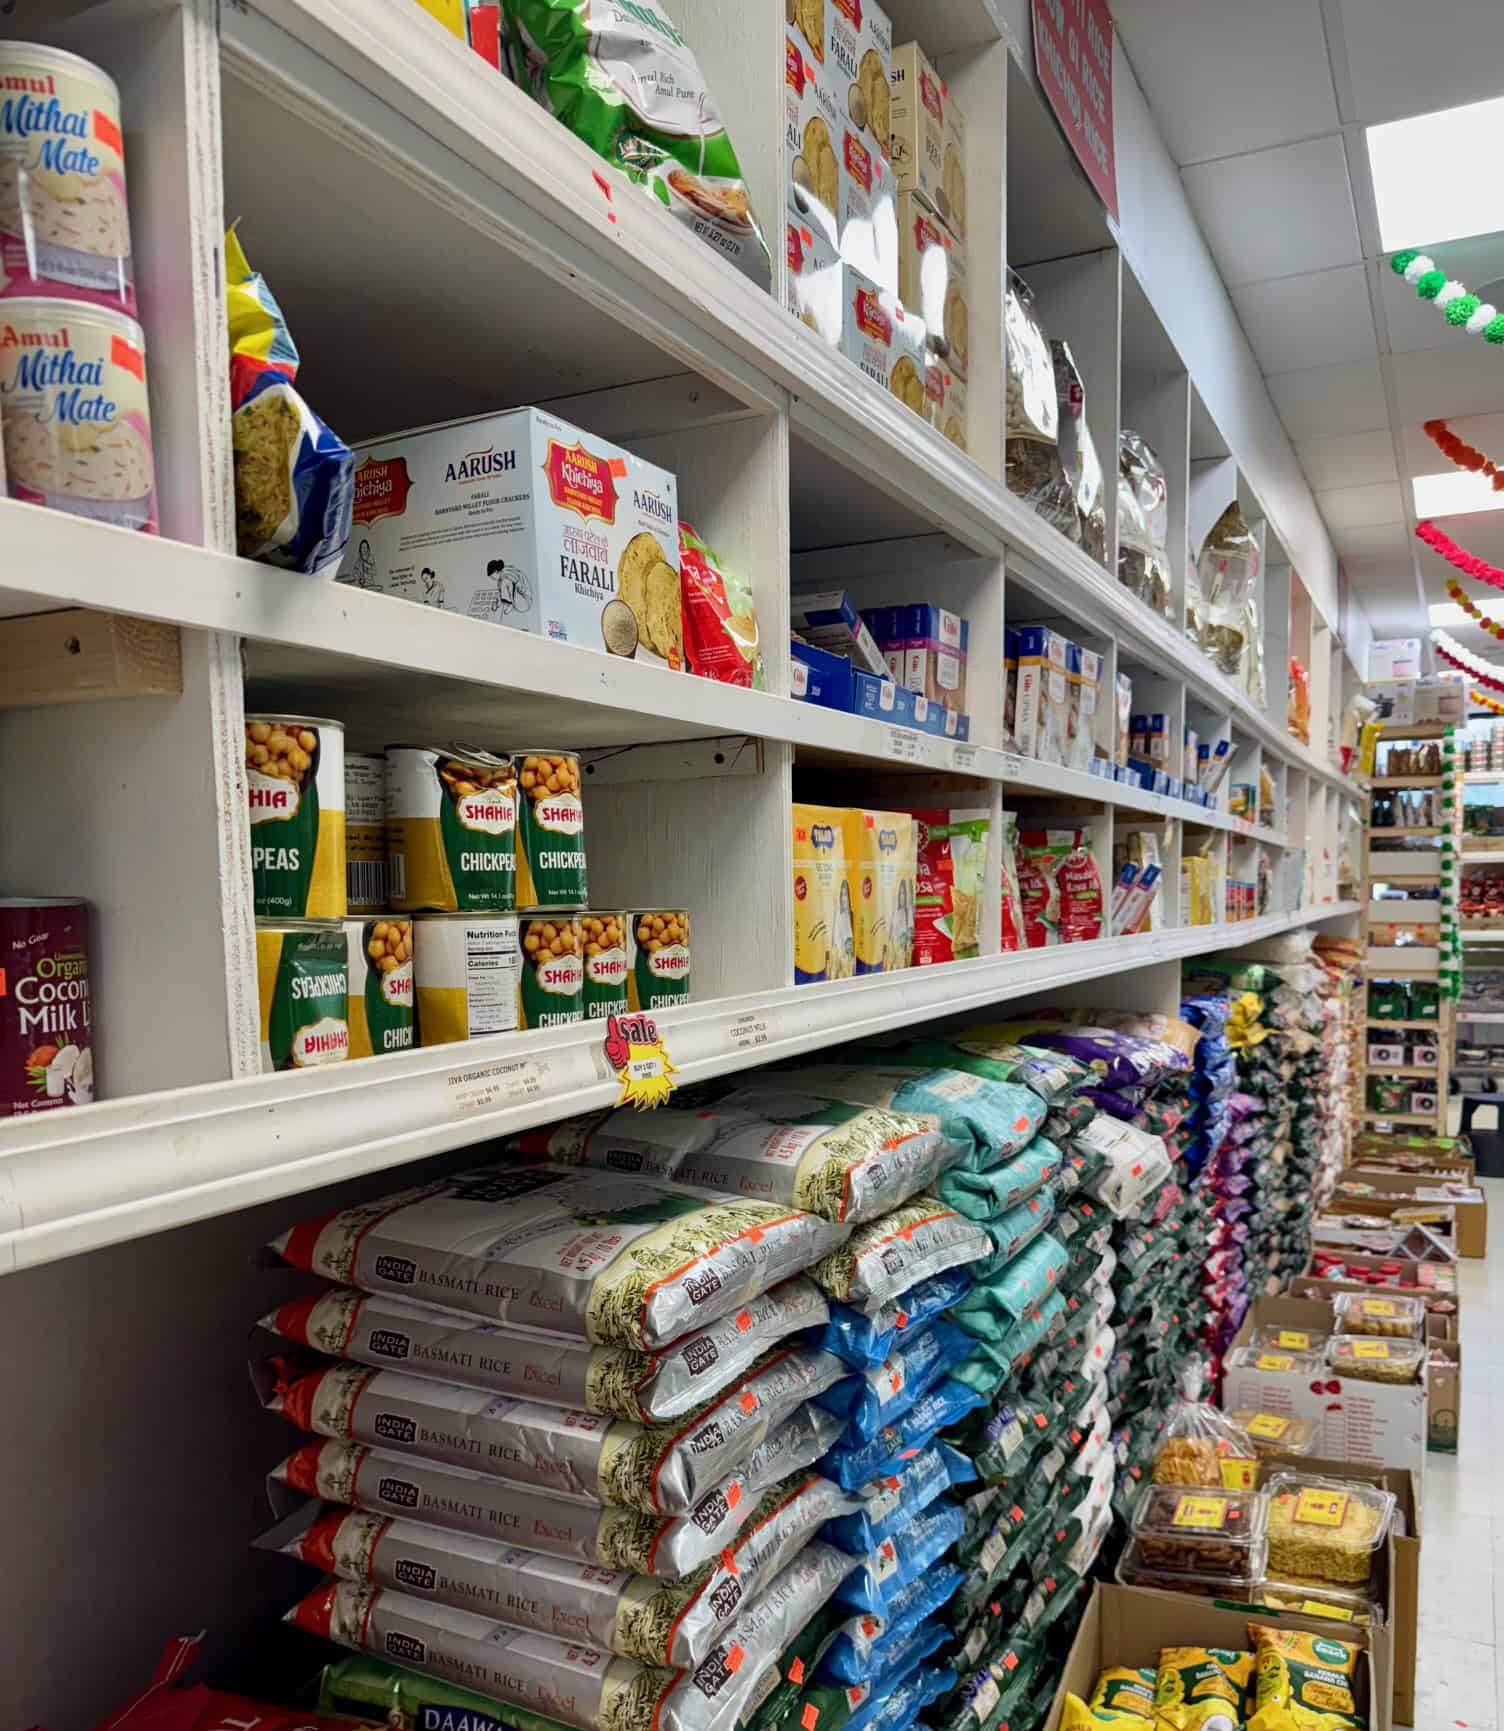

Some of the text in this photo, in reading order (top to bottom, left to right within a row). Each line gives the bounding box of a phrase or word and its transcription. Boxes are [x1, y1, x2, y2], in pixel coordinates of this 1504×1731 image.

[2, 94, 88, 138] Mithai
[38, 136, 100, 176] Mate
[1, 325, 70, 347] Amul
[12, 348, 104, 392] Mithai
[52, 388, 116, 425] Mate
[357, 465, 388, 481] ARUSH
[445, 449, 516, 482] AARUSH
[566, 451, 597, 474] AARUSH
[562, 461, 603, 495] Khichiya
[634, 490, 672, 524] AARUSH
[560, 554, 615, 593] FARALI
[574, 582, 604, 601] Khichiya
[250, 789, 287, 808] HIA
[253, 847, 300, 870] PEAS
[12, 941, 26, 951] No
[467, 930, 504, 939] Nutrition
[37, 957, 87, 980] Organ
[468, 960, 499, 968] Calories
[15, 976, 88, 1005] Cocon
[291, 972, 347, 999] CHICKPEAS
[389, 977, 412, 995] SHA
[18, 1003, 77, 1035] Milk
[621, 1019, 657, 1044] sale
[464, 1069, 491, 1081] ORGANIC
[492, 1064, 519, 1074] COCONUT
[377, 1256, 415, 1273] INDIA
[377, 1266, 413, 1283] GATE
[418, 1270, 479, 1294] BASMATI
[485, 1283, 519, 1300] RICE
[691, 1278, 721, 1303] GATE
[372, 1331, 410, 1350] INDIA
[372, 1341, 407, 1358] GATE
[684, 1335, 715, 1361] INDIA
[413, 1344, 562, 1386] BASMATI RICE Excel
[689, 1350, 718, 1376] GATE
[377, 1424, 412, 1442] GATE
[378, 1415, 414, 1434] INDIA
[420, 1429, 482, 1454] BASMATI
[489, 1444, 521, 1463] RICE
[381, 1478, 418, 1498] INDIA
[381, 1489, 416, 1507] GATE
[423, 1494, 573, 1541] BASMATI RICE Excel
[694, 1489, 724, 1526] INDIA
[701, 1504, 729, 1535] GATE
[397, 1560, 435, 1581] INDIA
[397, 1571, 434, 1589] GATE
[440, 1575, 591, 1630] BASMATI RICE Excel
[710, 1576, 738, 1609] INDIA
[387, 1632, 425, 1654] INDIA
[428, 1651, 488, 1681] BASMATI
[493, 1671, 525, 1693] RICE
[693, 1650, 726, 1692] INDIA
[704, 1663, 732, 1699] GAT
